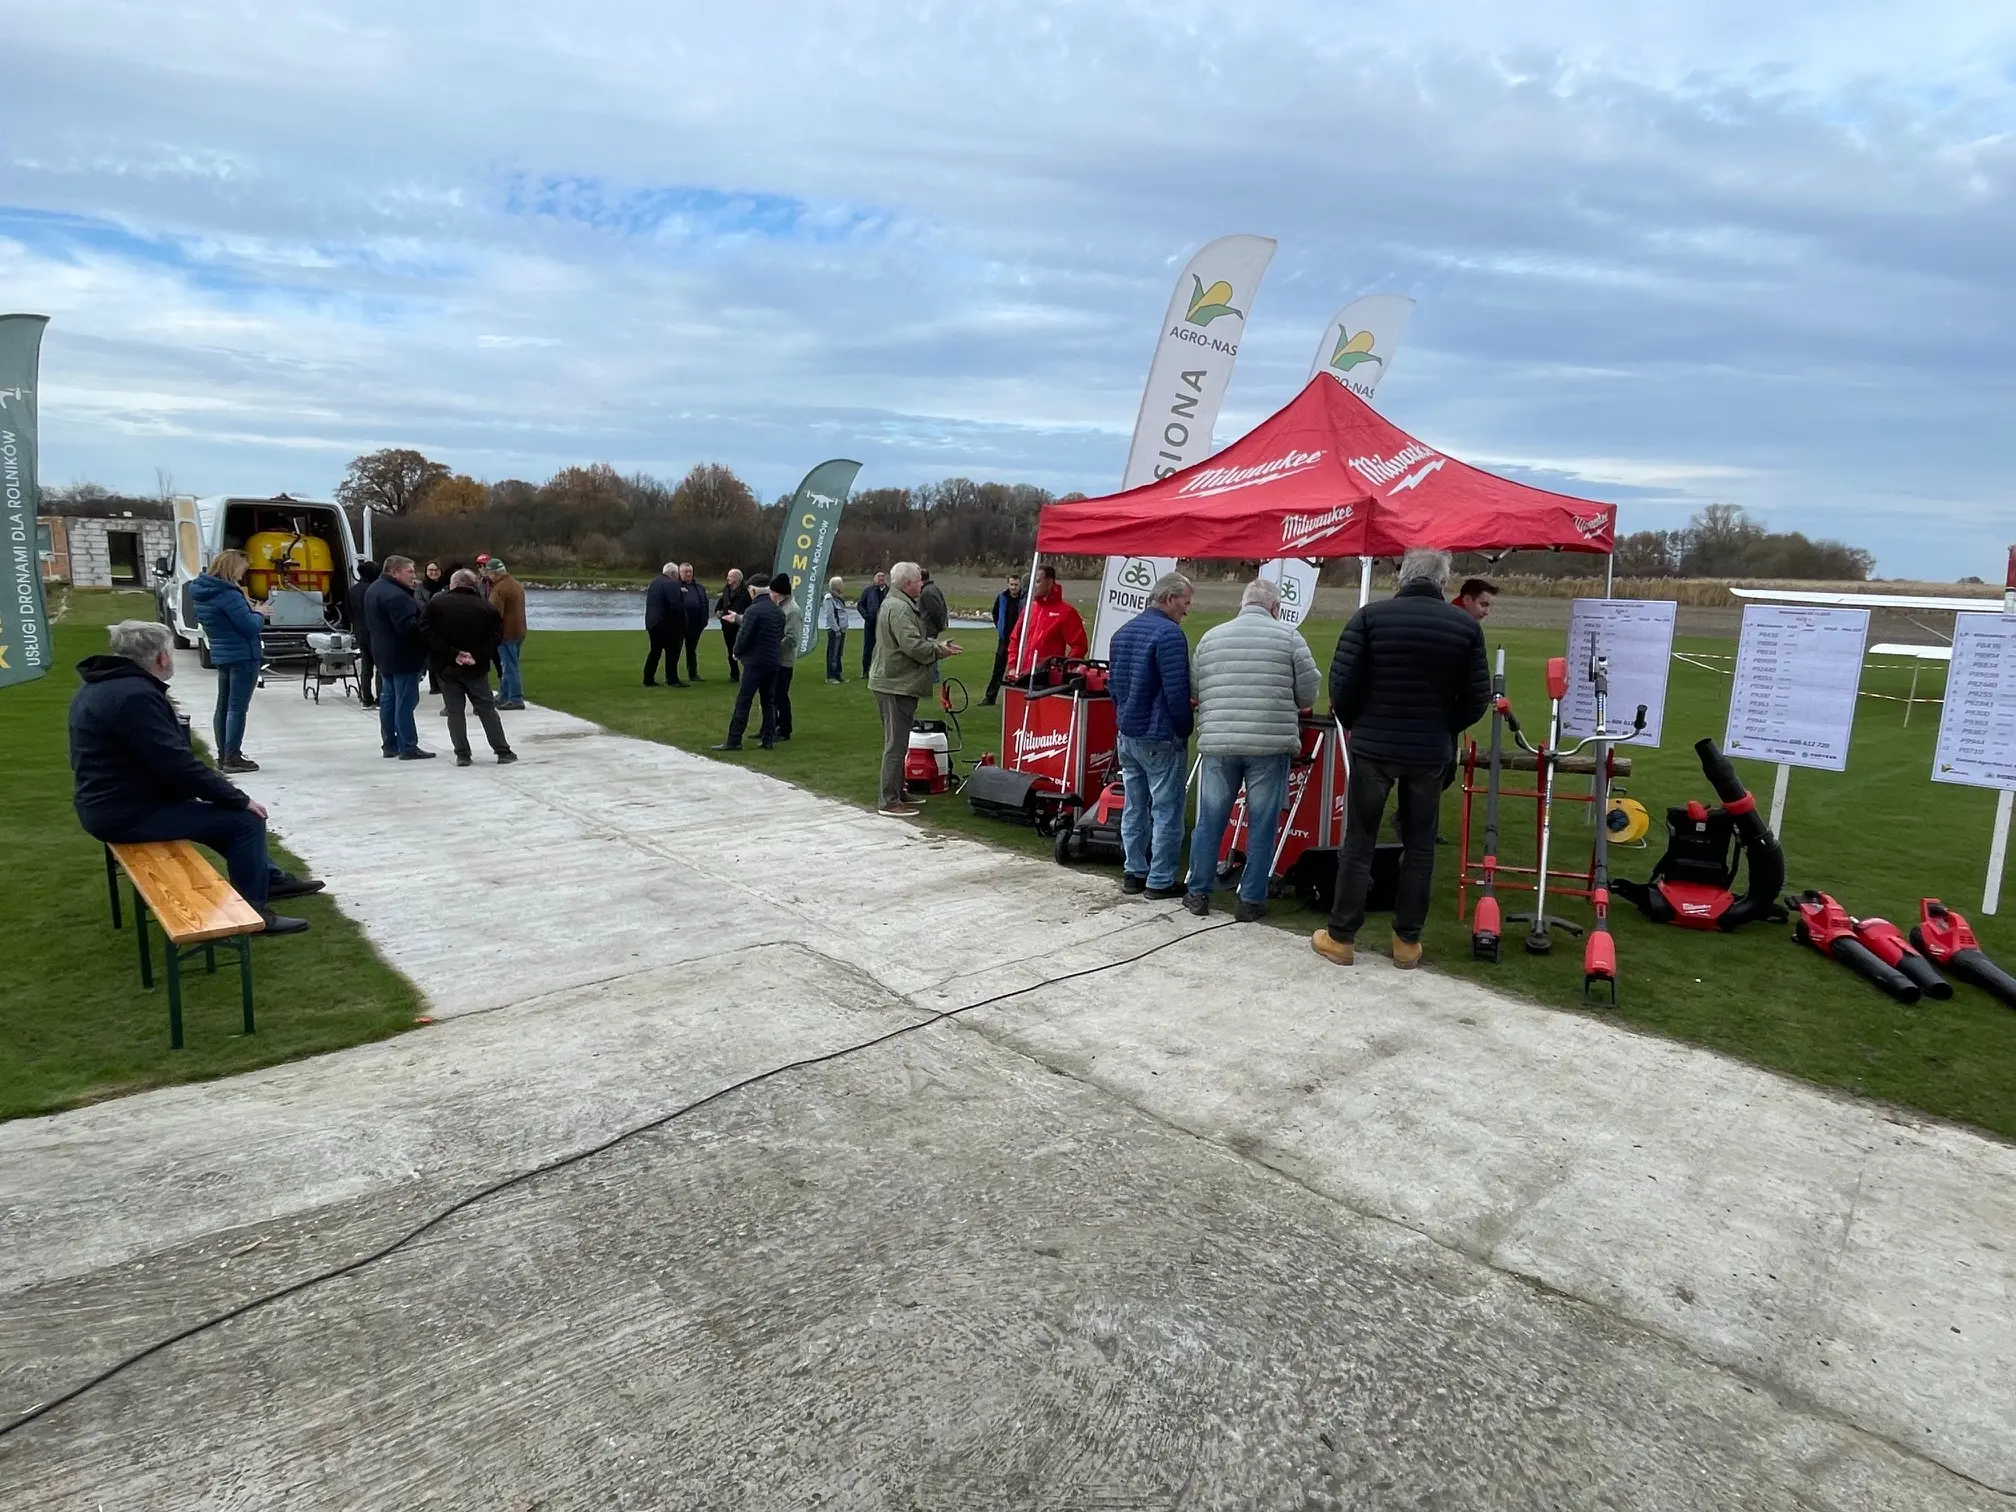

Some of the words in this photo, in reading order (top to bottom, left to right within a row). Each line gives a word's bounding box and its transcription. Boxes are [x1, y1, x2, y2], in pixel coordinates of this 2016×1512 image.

[1169, 326, 1238, 356] AGRO-NAS
[3, 430, 22, 508] ROLNIKÓW
[1179, 450, 1323, 493] Milwaukee
[11, 514, 26, 542] DLA
[813, 520, 829, 564] ROLNIKÓW
[1281, 505, 1354, 542] Milwaukee
[14, 546, 34, 614] DRONAMI
[809, 565, 818, 582] DLA
[804, 583, 815, 623] DRONAMI
[21, 619, 41, 666] USŁUGI
[1012, 728, 1068, 754] Milwaukee
